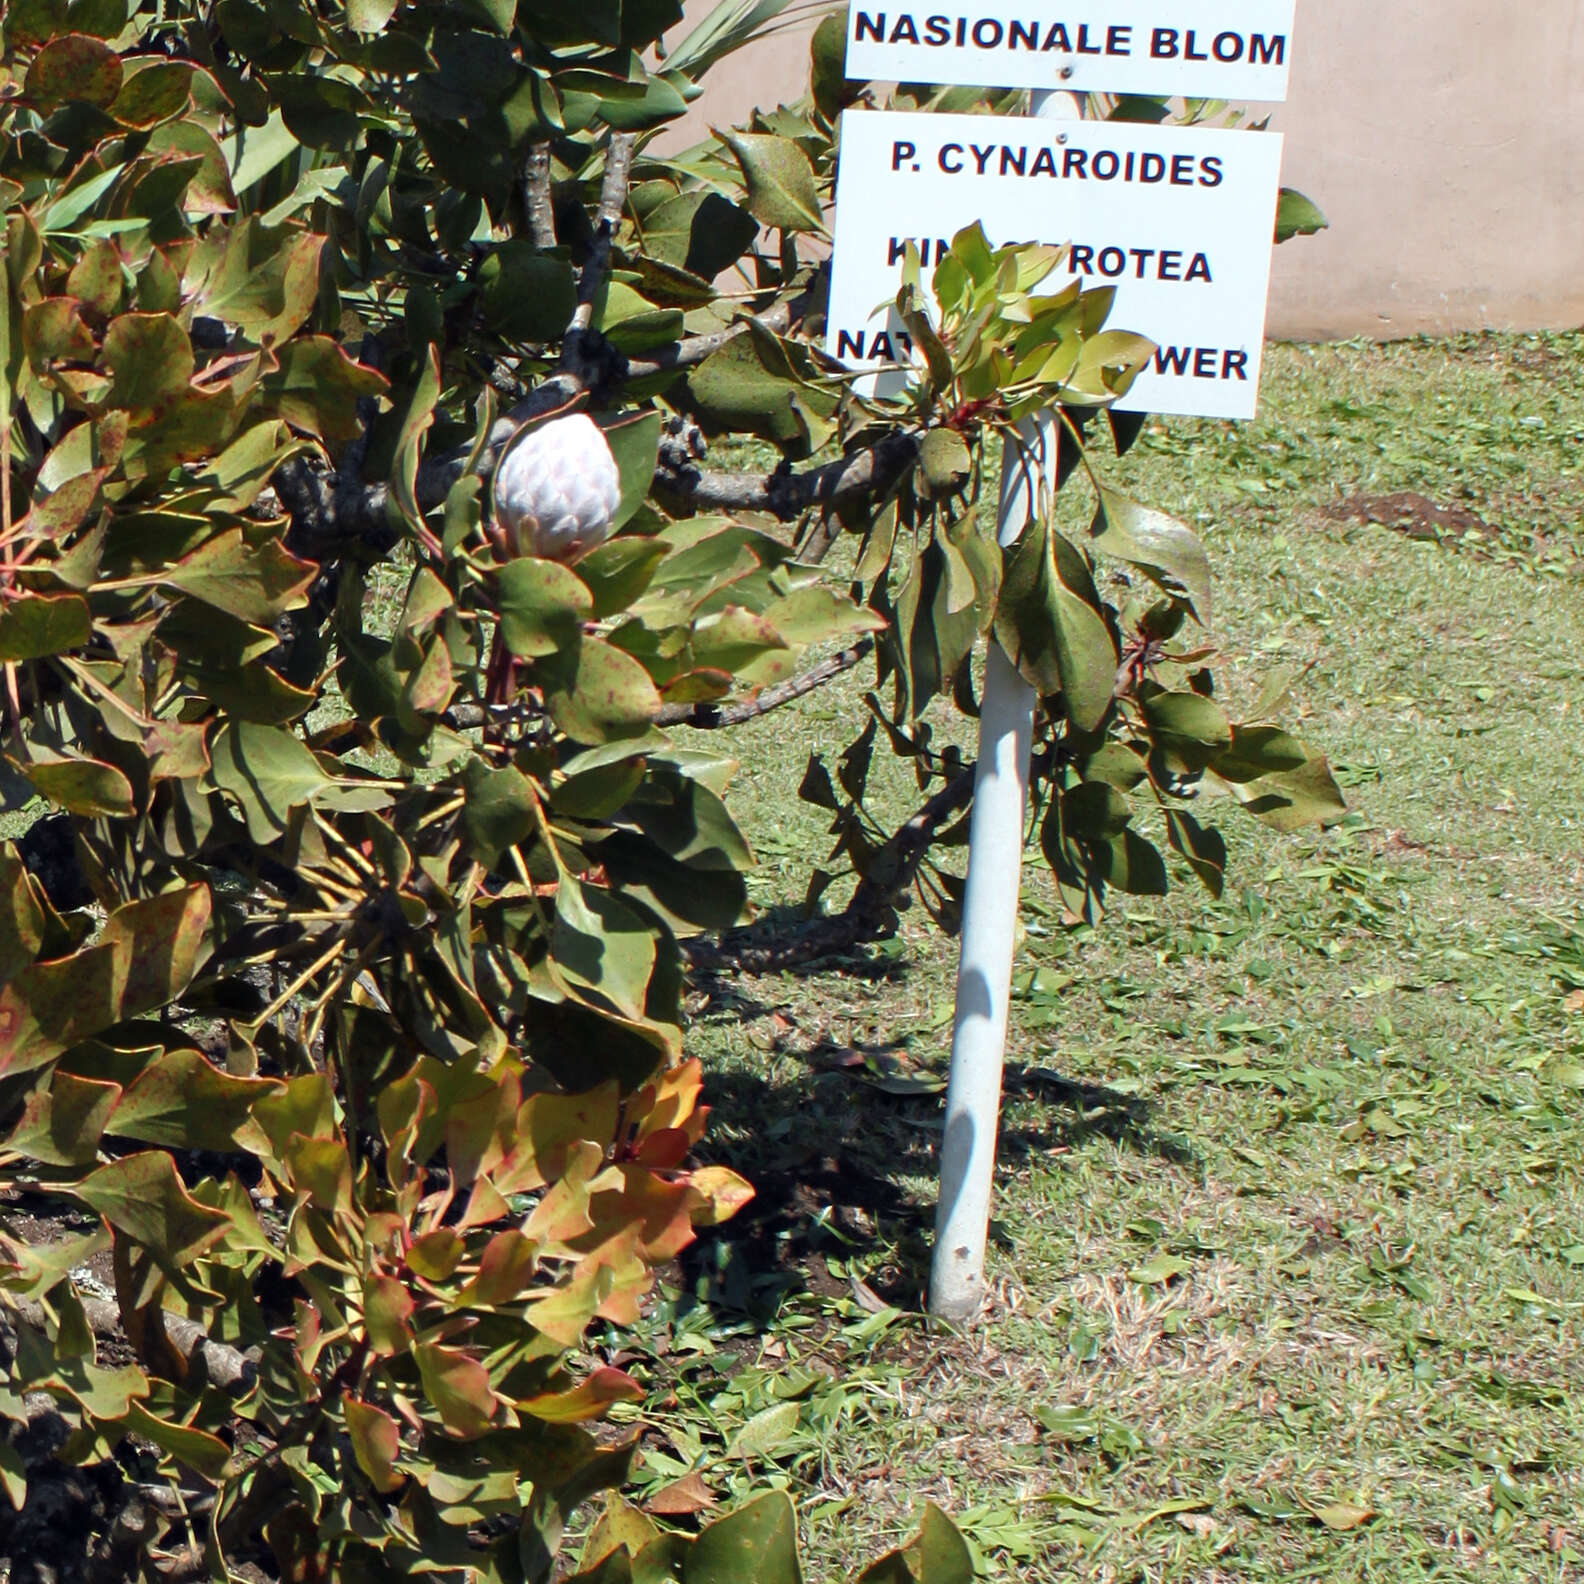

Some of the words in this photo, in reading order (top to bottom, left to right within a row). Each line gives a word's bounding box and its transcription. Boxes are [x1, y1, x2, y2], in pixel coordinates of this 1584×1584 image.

[855, 11, 1132, 57] NASIONALE
[1150, 27, 1285, 66] BLOM
[892, 141, 920, 172] P.
[938, 143, 1223, 187] CYNAROIDES
[1042, 243, 1212, 283] ROTEA
